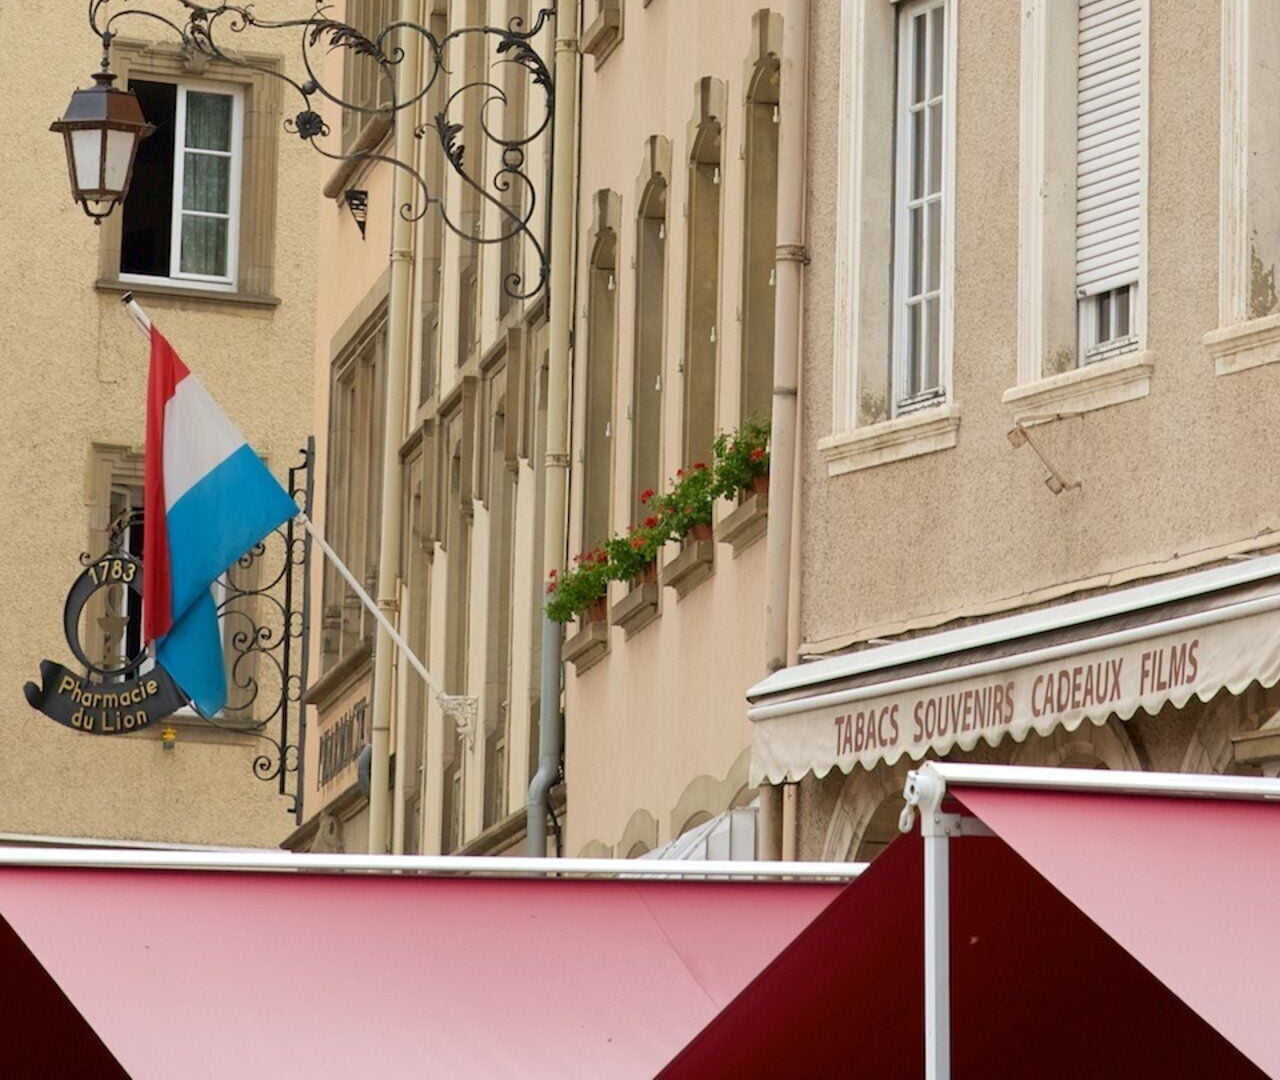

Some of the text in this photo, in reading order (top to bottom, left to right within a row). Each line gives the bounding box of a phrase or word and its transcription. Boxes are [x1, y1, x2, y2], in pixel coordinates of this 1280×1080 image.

[88, 560, 136, 585] 1783
[58, 676, 158, 707] Pharmacie
[835, 639, 1199, 756] TABACS SOUVENIRS CADEAUX FILMS
[71, 707, 148, 731] du Lion
